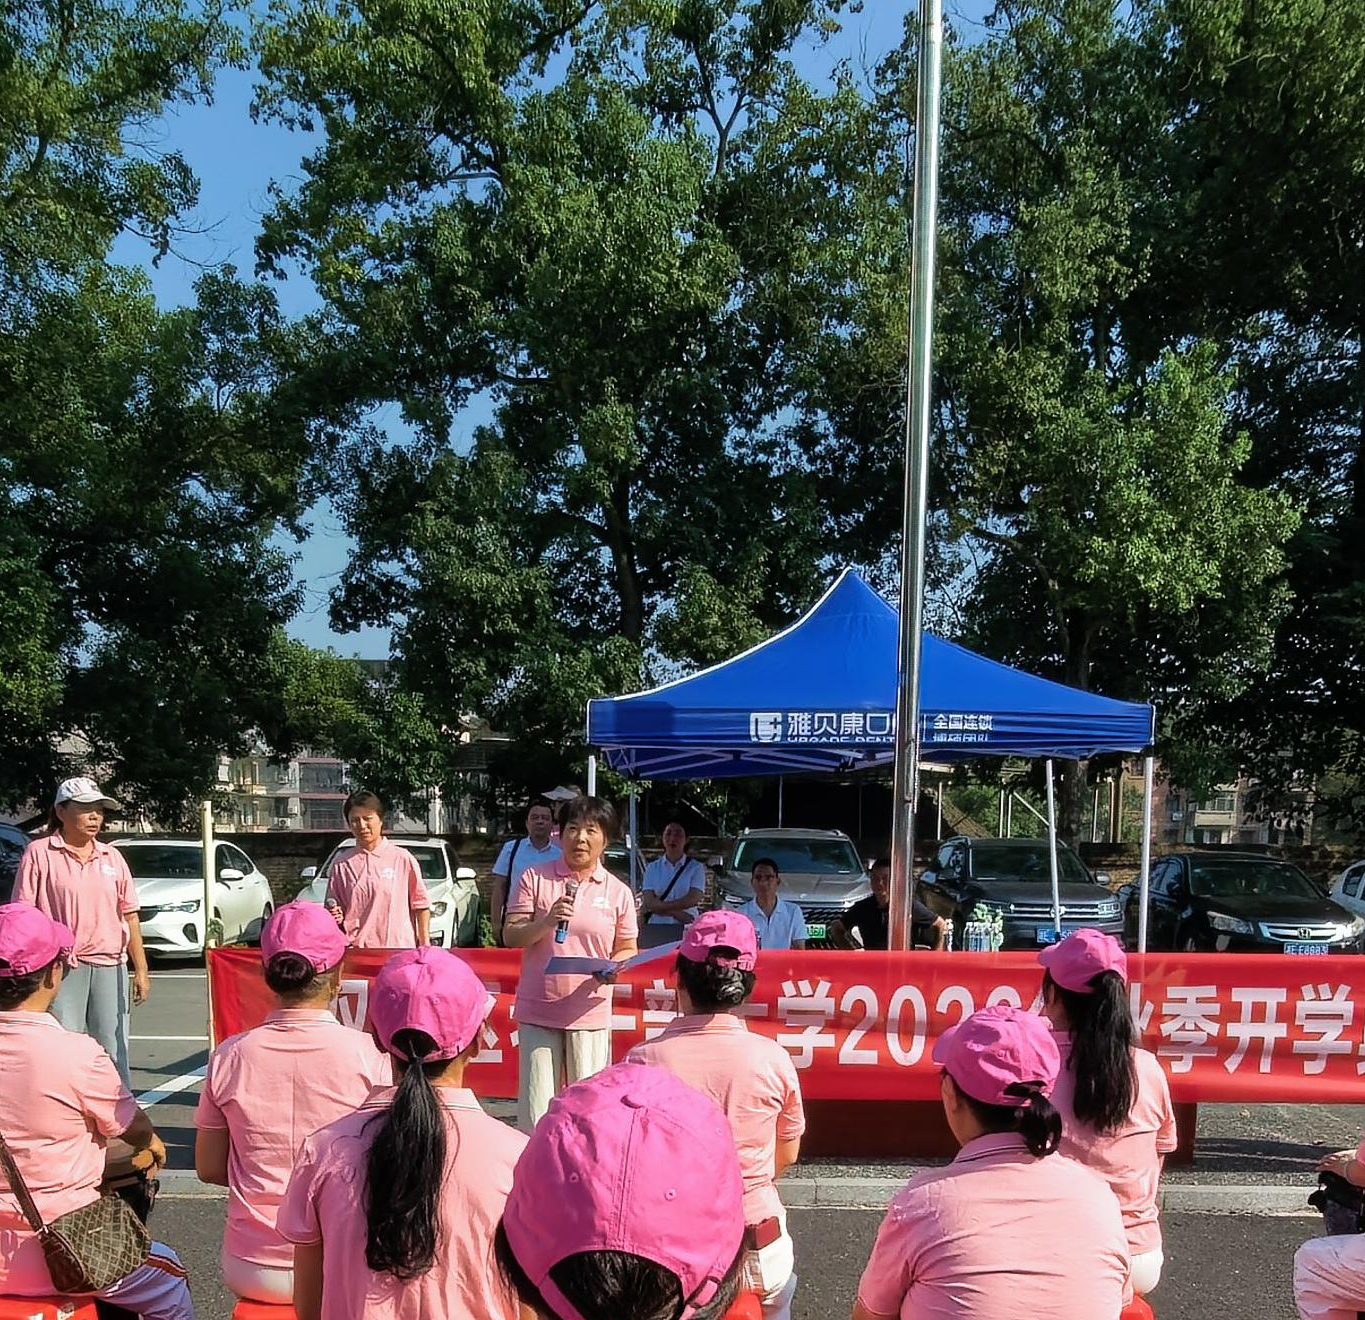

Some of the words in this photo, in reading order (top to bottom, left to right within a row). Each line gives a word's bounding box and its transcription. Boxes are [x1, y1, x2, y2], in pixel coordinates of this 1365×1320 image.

[787, 712, 896, 735] 雅贝康口
[933, 714, 994, 731] 全国连锁
